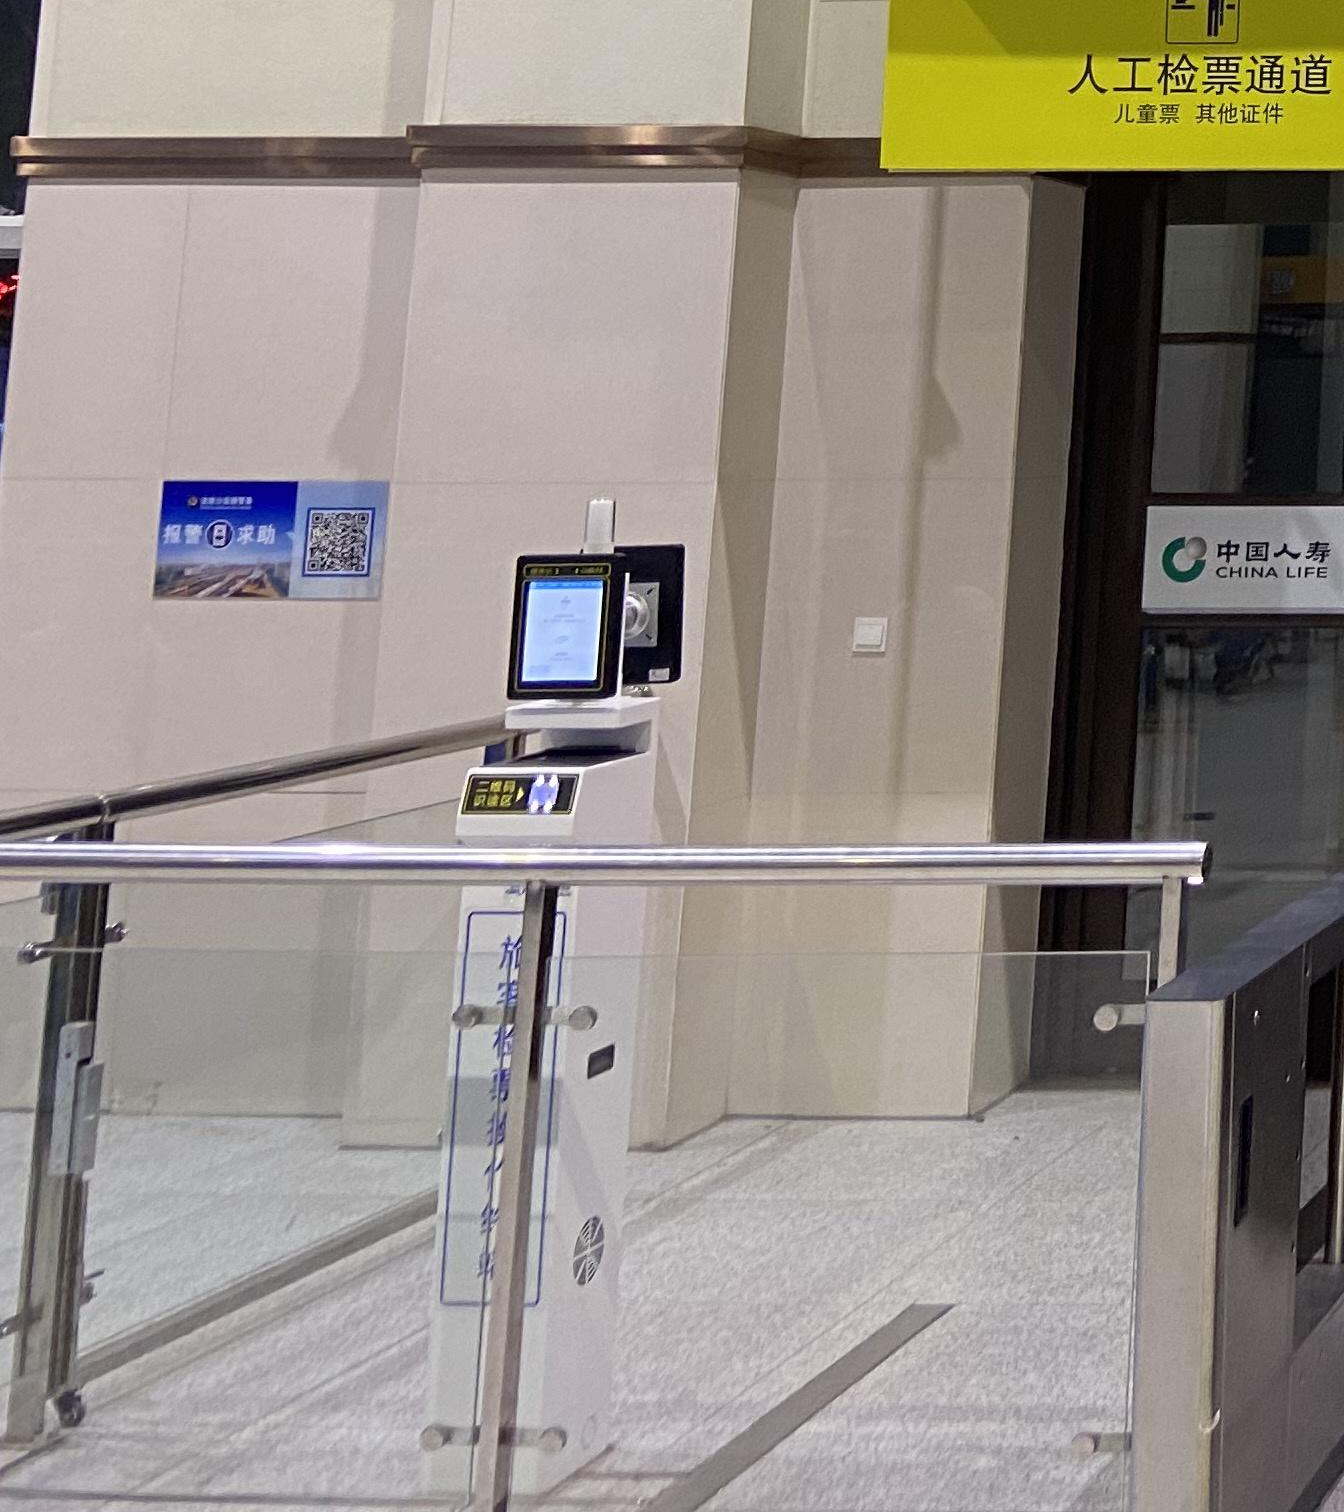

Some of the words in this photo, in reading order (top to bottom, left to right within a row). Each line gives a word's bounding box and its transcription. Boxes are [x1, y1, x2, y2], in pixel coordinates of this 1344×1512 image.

[1067, 53, 1333, 96] 人工检票通道
[1113, 103, 1181, 125] 儿童票
[1195, 102, 1285, 125] 其他证件
[1216, 539, 1332, 563] 中国人寿
[1215, 566, 1279, 579] CHINA
[1285, 566, 1329, 579] LIFE
